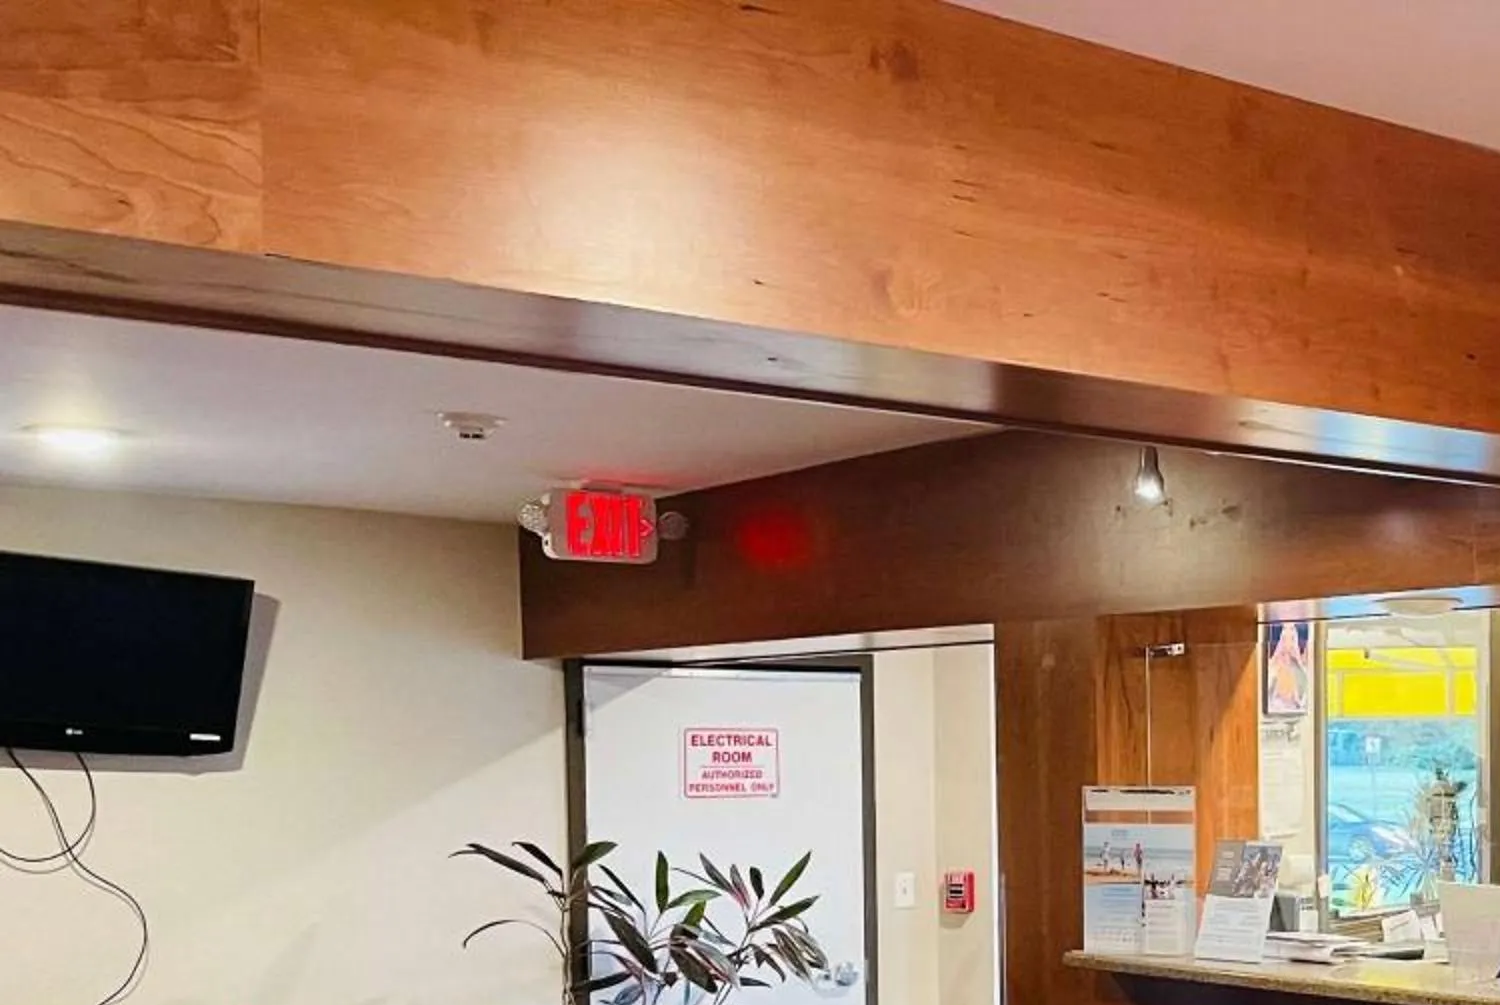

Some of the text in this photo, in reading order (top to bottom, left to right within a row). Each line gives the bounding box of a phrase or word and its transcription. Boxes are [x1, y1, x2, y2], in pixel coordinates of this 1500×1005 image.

[566, 493, 642, 557] EXIT
[691, 734, 773, 747] ELECTRICAL
[712, 751, 753, 763] ROOM
[701, 769, 764, 780] AUTHORIZED
[689, 782, 775, 793] PERSONNEL ONLY
